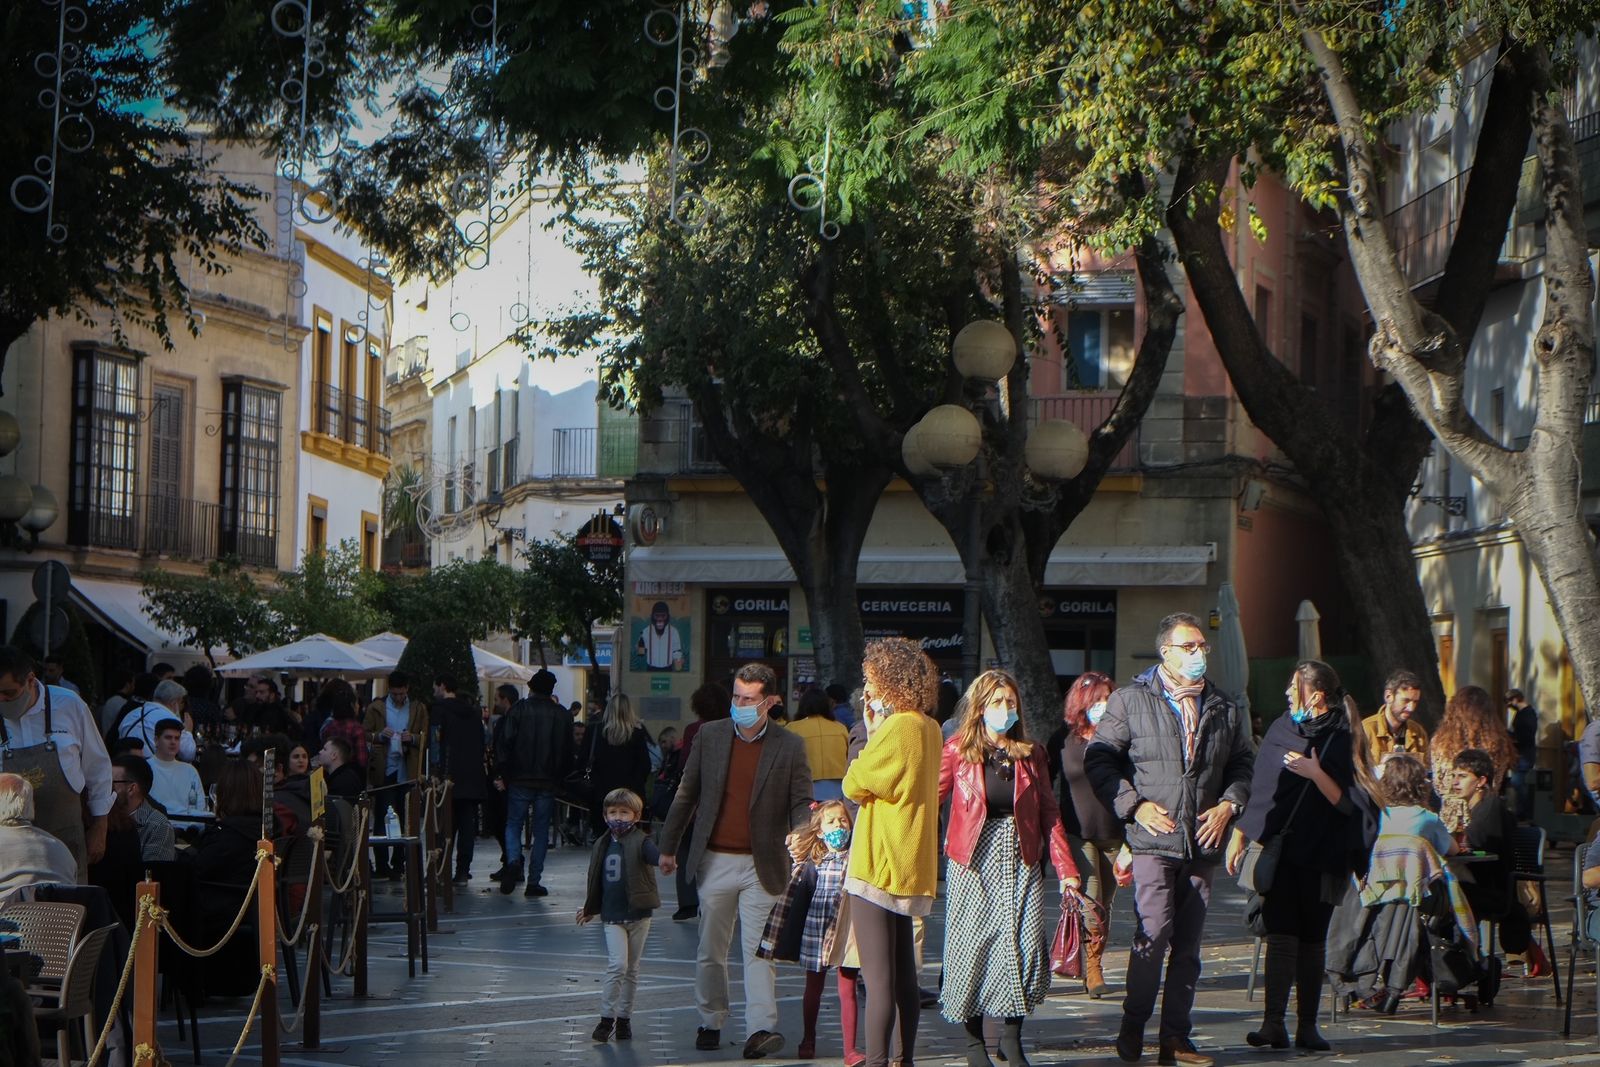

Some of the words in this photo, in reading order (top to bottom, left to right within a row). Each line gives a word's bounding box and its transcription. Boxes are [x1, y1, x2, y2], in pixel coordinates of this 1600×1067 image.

[635, 581, 658, 595] KING
[661, 581, 686, 595] BEER
[734, 599, 789, 611] GORILA
[861, 600, 952, 612] CERVECERIA
[1059, 601, 1115, 613] GORILA
[605, 853, 622, 882] 9
